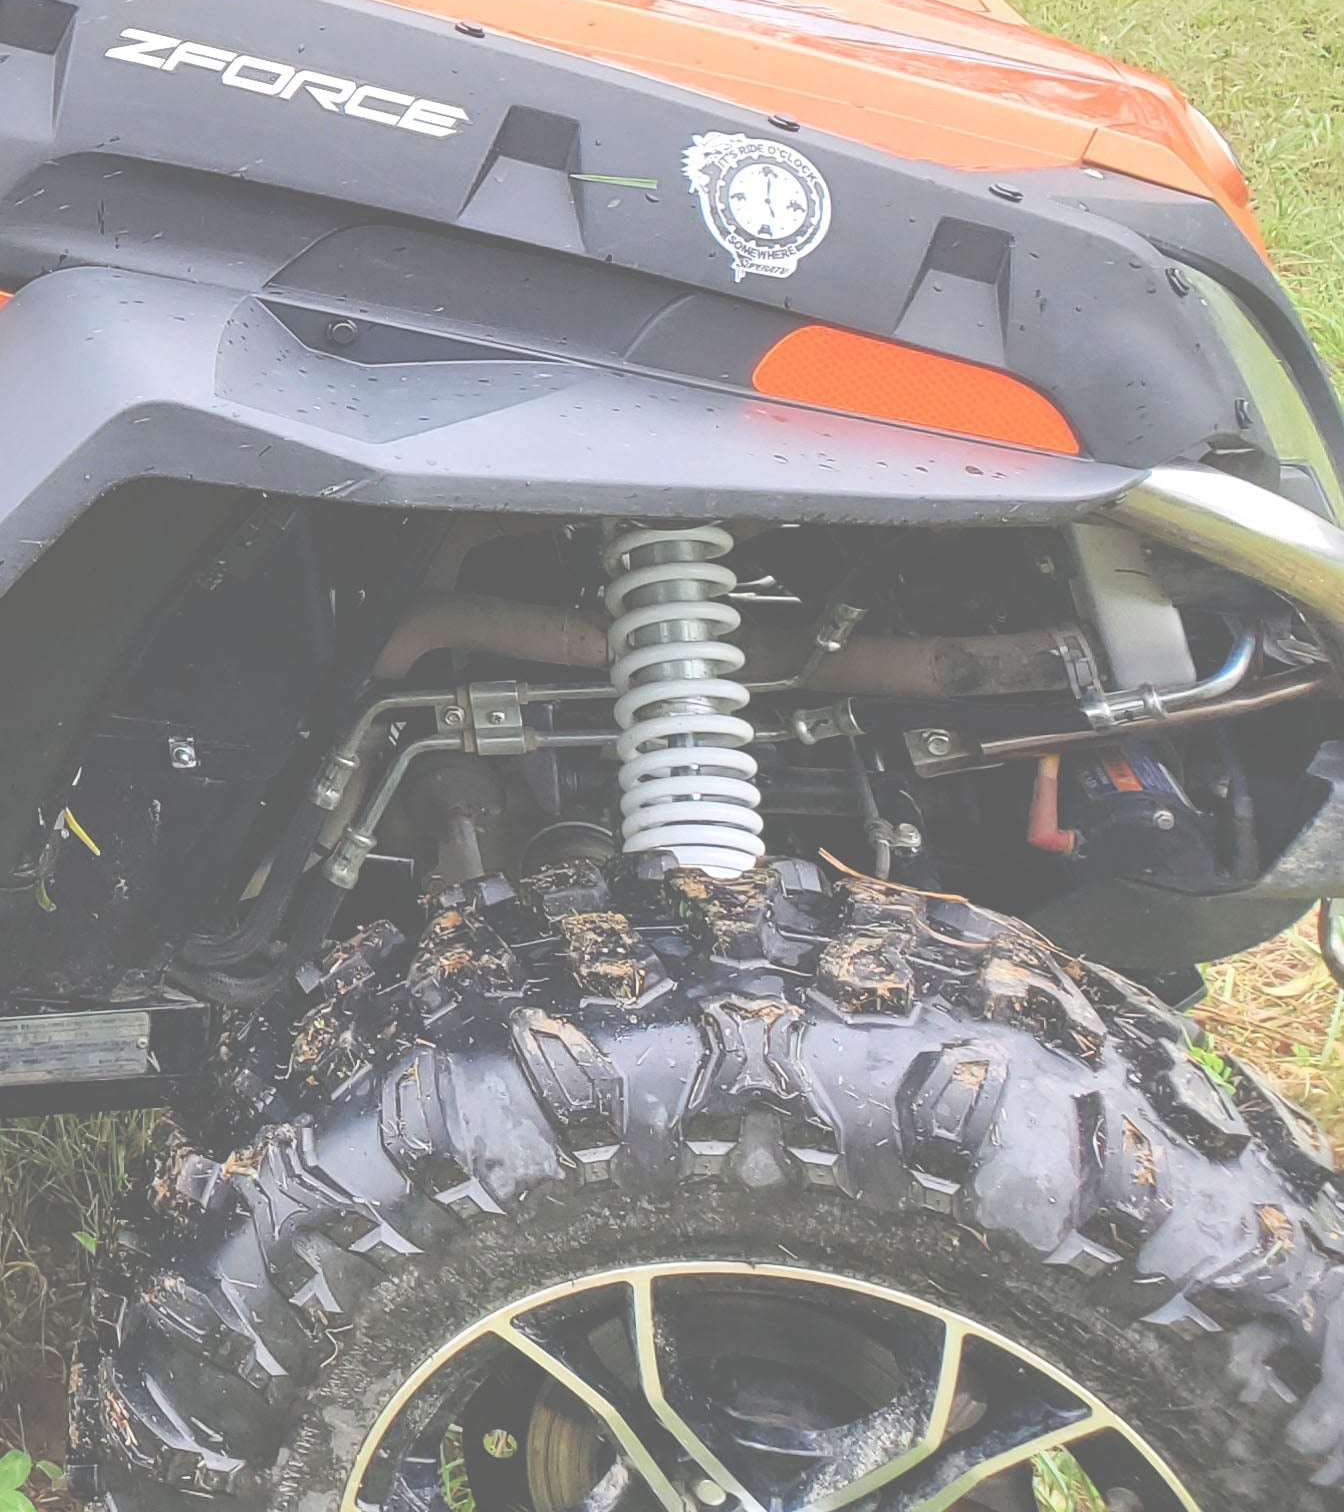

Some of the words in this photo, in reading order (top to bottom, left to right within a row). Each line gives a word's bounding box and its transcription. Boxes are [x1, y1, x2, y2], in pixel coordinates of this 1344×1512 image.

[103, 27, 472, 138] ZFORCE
[717, 148, 739, 169] IT'S
[738, 143, 765, 156] RIDE
[767, 144, 817, 184] O'CLOCK
[726, 234, 798, 261] SOMEWHERE
